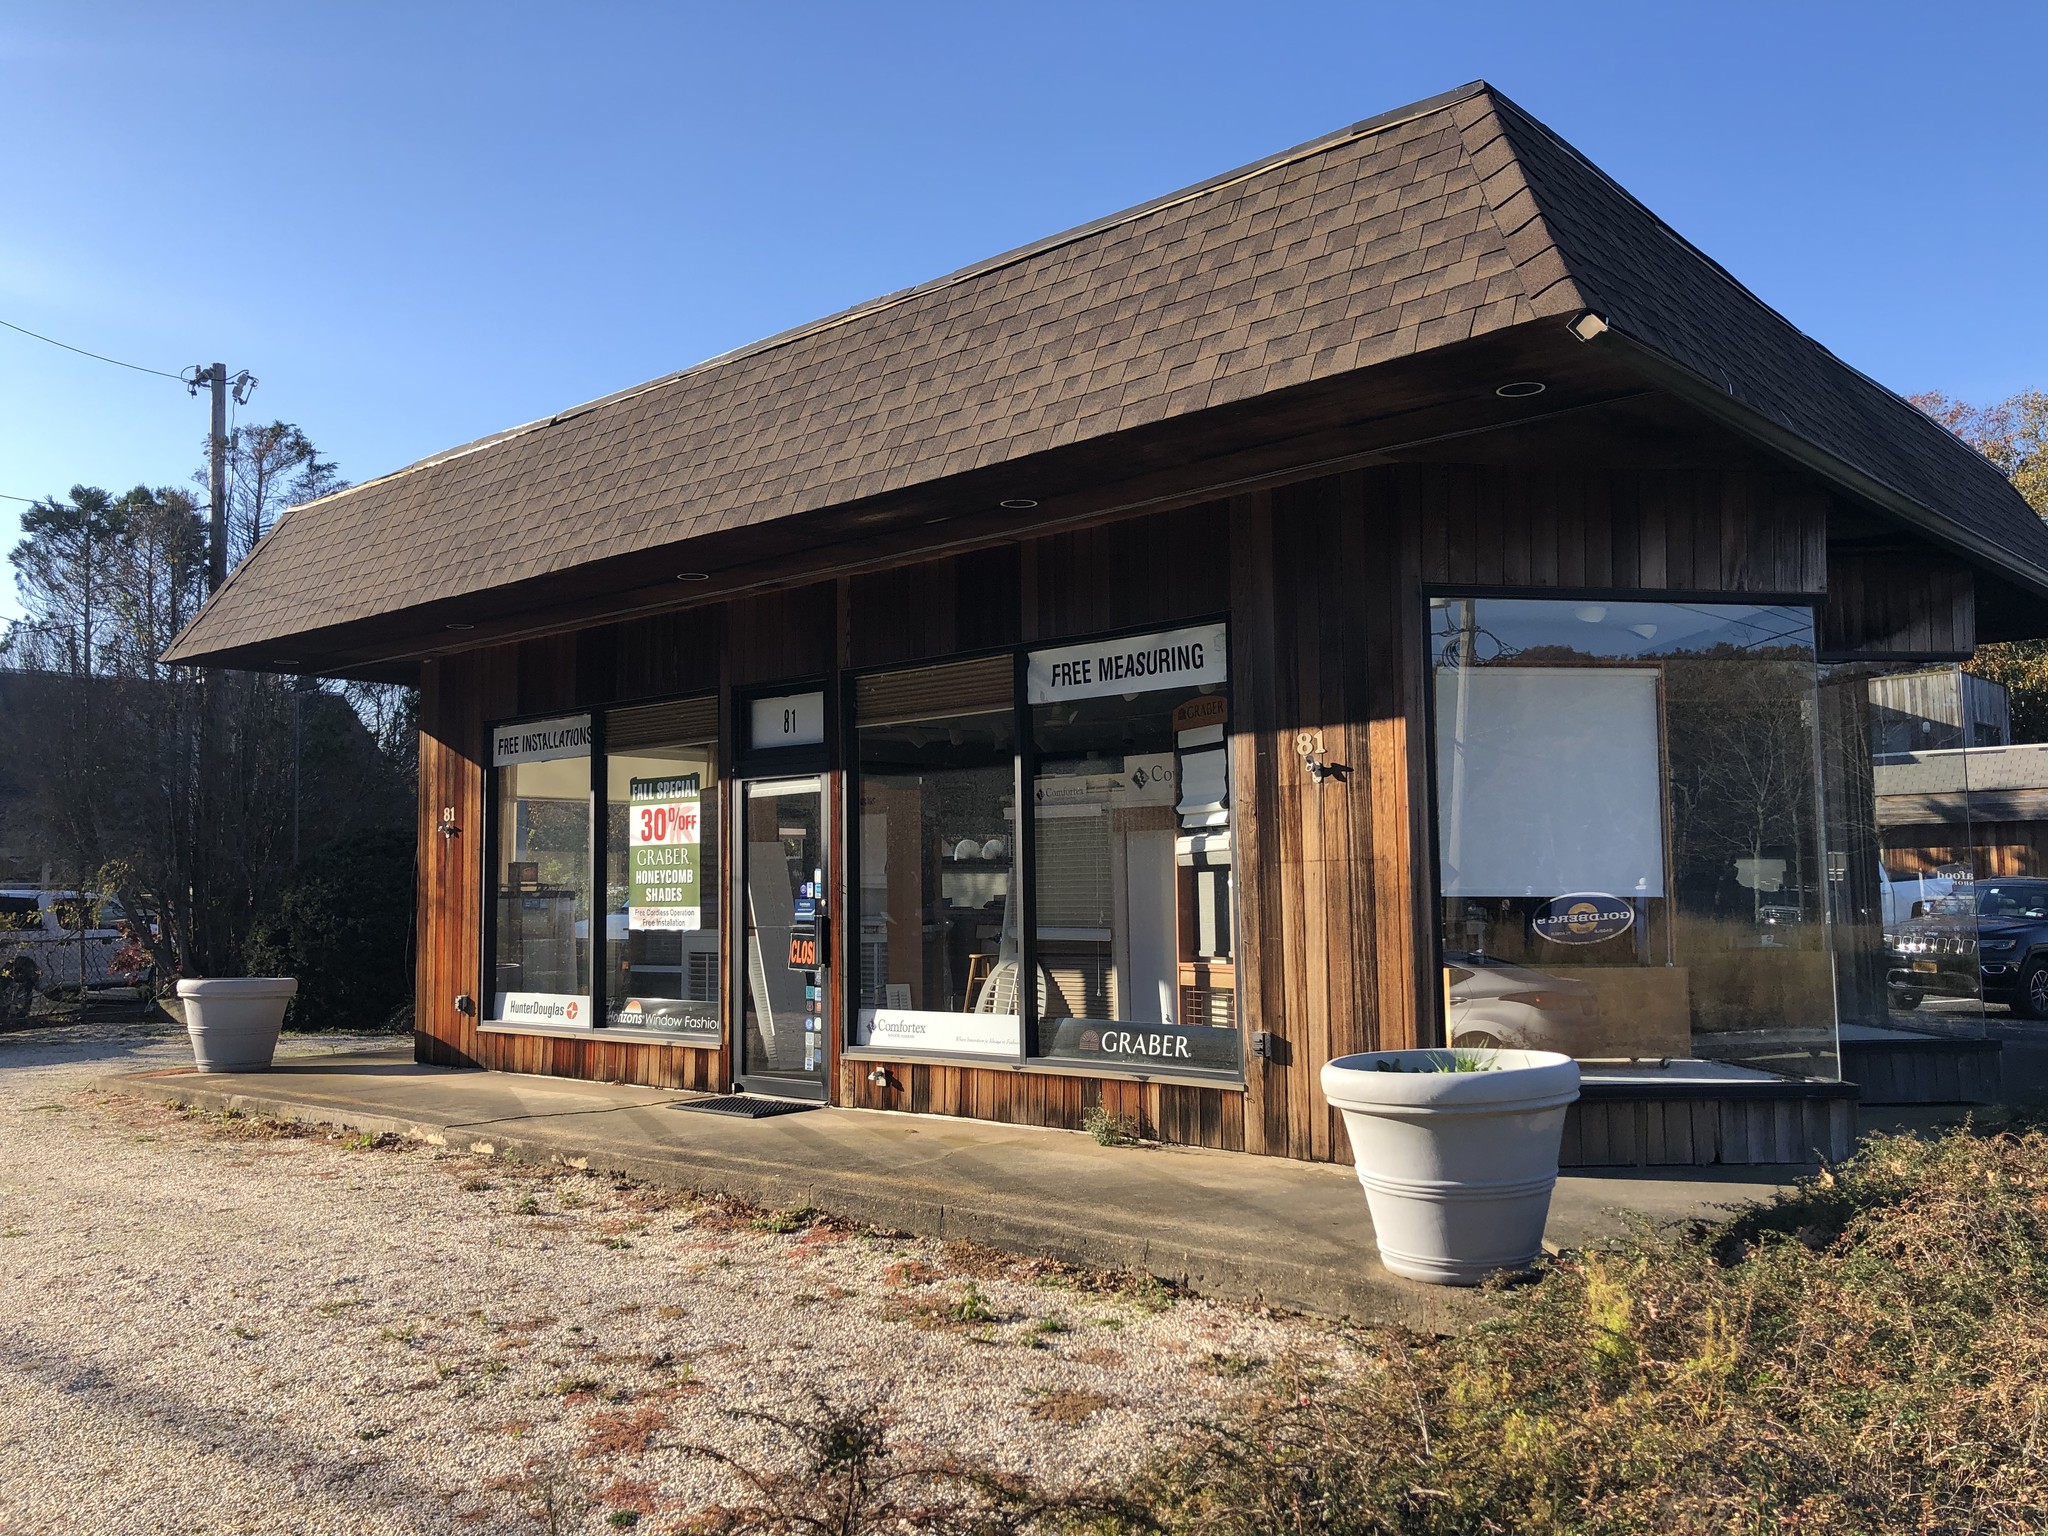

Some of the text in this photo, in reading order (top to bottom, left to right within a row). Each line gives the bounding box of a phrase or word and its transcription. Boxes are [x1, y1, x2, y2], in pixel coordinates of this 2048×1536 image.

[1051, 643, 1204, 687] FREE MEASURING
[1186, 700, 1224, 719] GRABER
[783, 708, 796, 733] 81
[497, 725, 592, 755] FREE INSTALLATIONS
[1296, 730, 1326, 755] 81
[632, 779, 697, 801] FALL SPECIAL
[443, 807, 455, 821] 81
[679, 815, 697, 830] OFF
[637, 848, 689, 866] GRABER
[635, 869, 693, 884] HONEYCOMB
[645, 887, 683, 902] SHADES
[635, 908, 694, 918] Free Cordless Operation
[642, 918, 685, 927] Free Installation
[790, 939, 815, 964] CLOS
[510, 1000, 564, 1018] HunterDouglas
[645, 1013, 682, 1026] Window
[878, 1018, 926, 1034] Comfortex
[1101, 1031, 1189, 1058] GRABER
